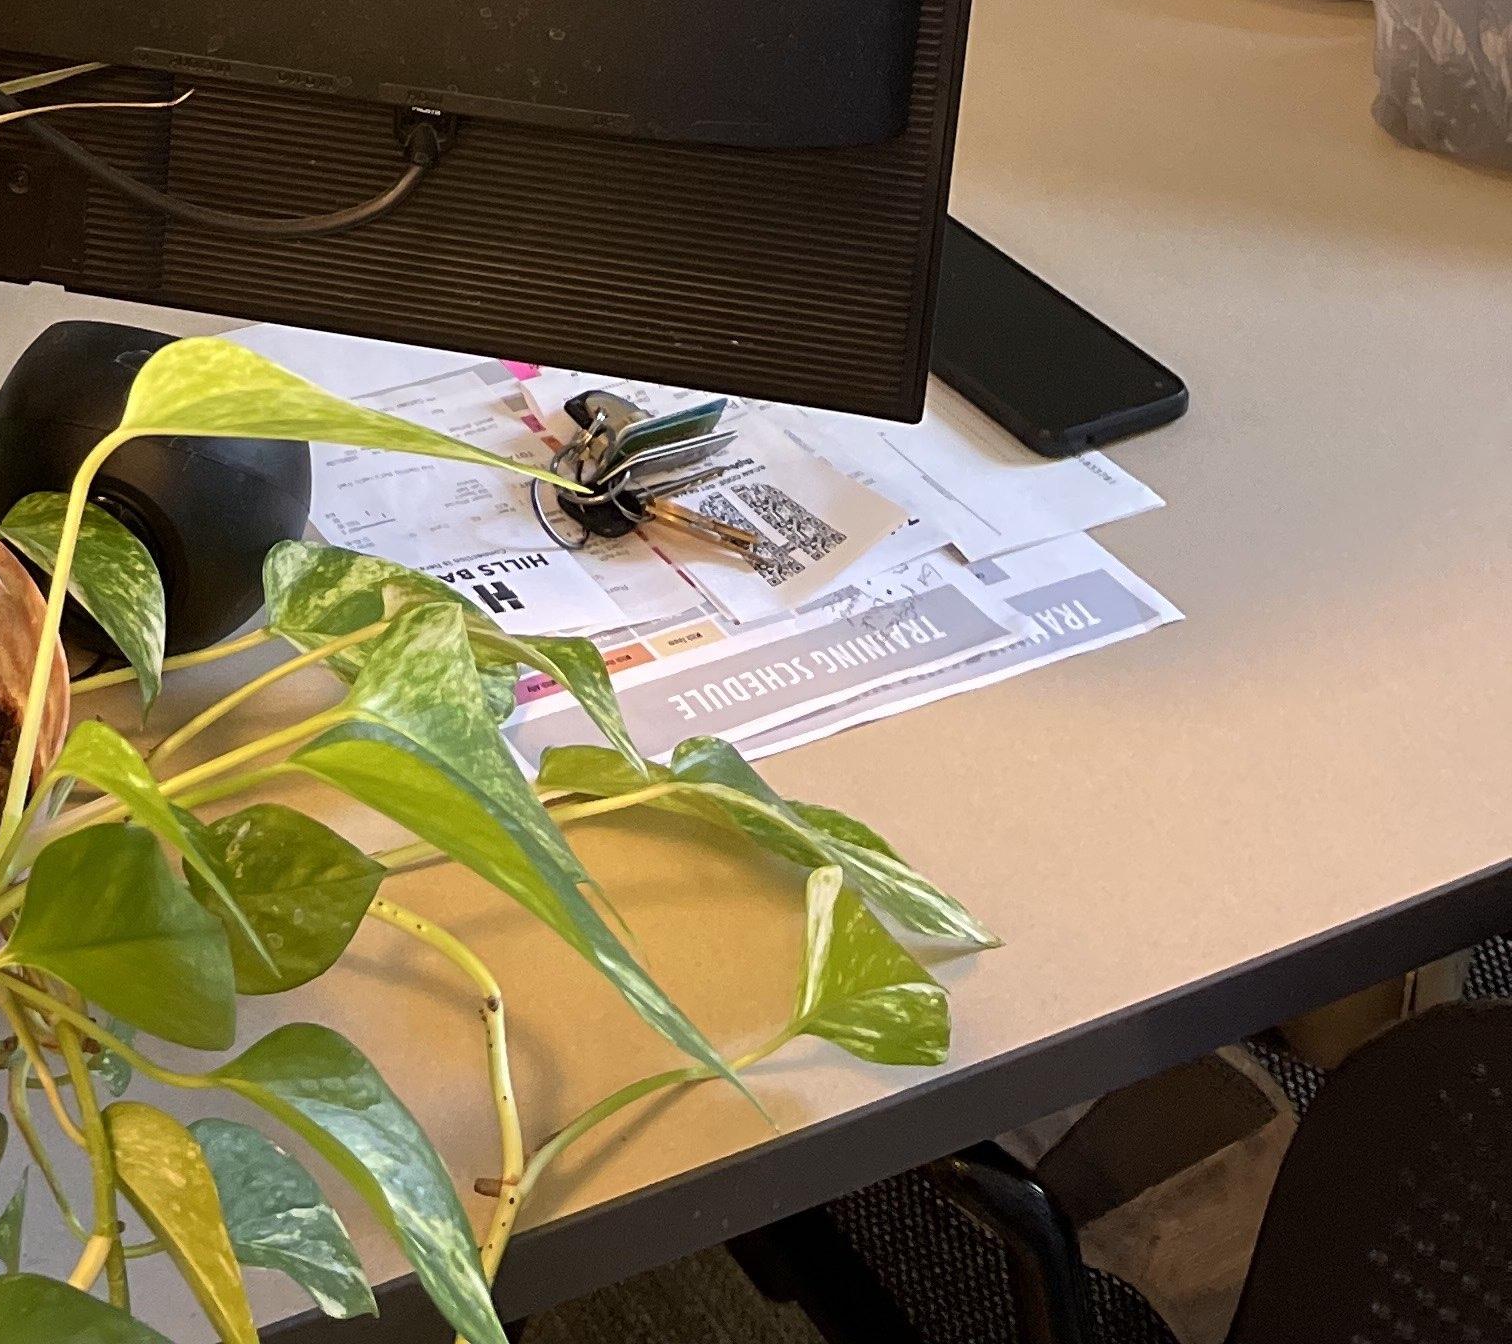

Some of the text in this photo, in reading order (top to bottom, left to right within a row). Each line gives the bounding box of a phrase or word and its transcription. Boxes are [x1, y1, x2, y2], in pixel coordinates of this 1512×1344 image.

[477, 553, 550, 577] HILLS
[666, 613, 949, 721] TRAINING SCHEDULE
